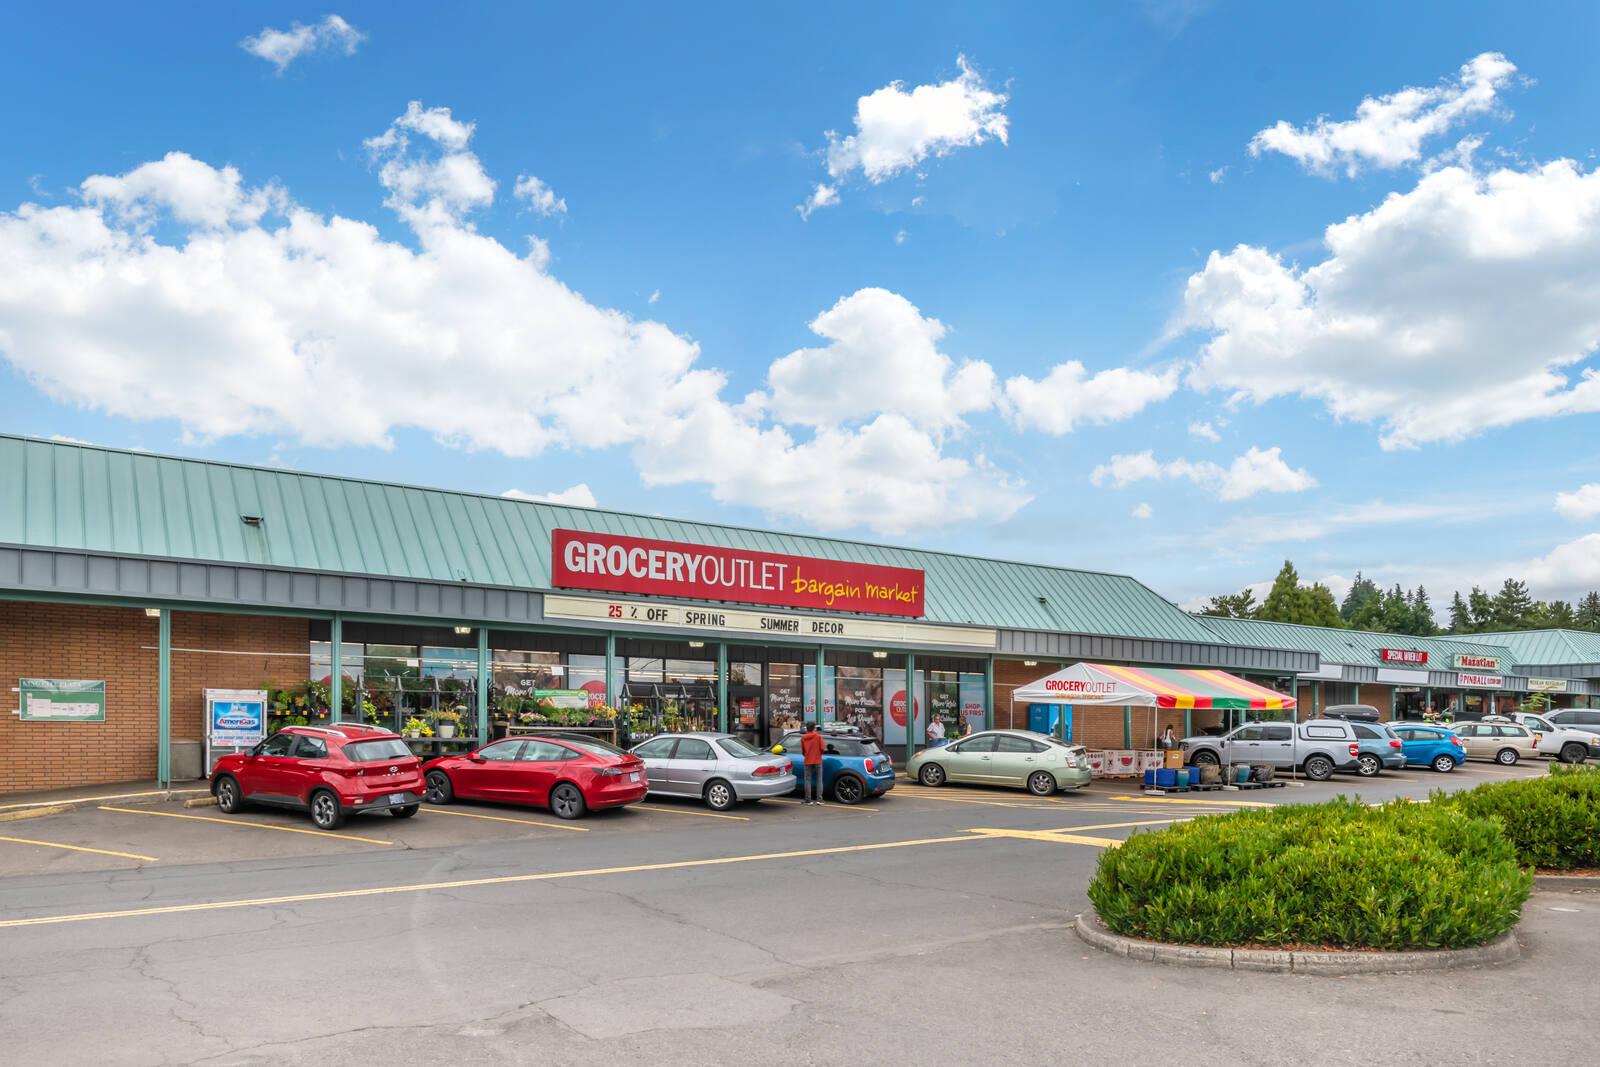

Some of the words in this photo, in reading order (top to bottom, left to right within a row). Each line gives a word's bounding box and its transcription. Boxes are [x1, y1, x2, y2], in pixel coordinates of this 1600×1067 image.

[791, 566, 861, 606] bargain
[865, 581, 919, 604] market
[608, 605, 623, 618] 25
[631, 606, 638, 619] %
[647, 608, 669, 621] OFF
[685, 611, 726, 626] SPRING
[760, 617, 799, 632] SUMMER
[812, 621, 844, 634] DECOR
[1461, 655, 1496, 668] Mazatlan
[1463, 673, 1487, 685] PINBALL
[969, 709, 985, 717] FIRST
